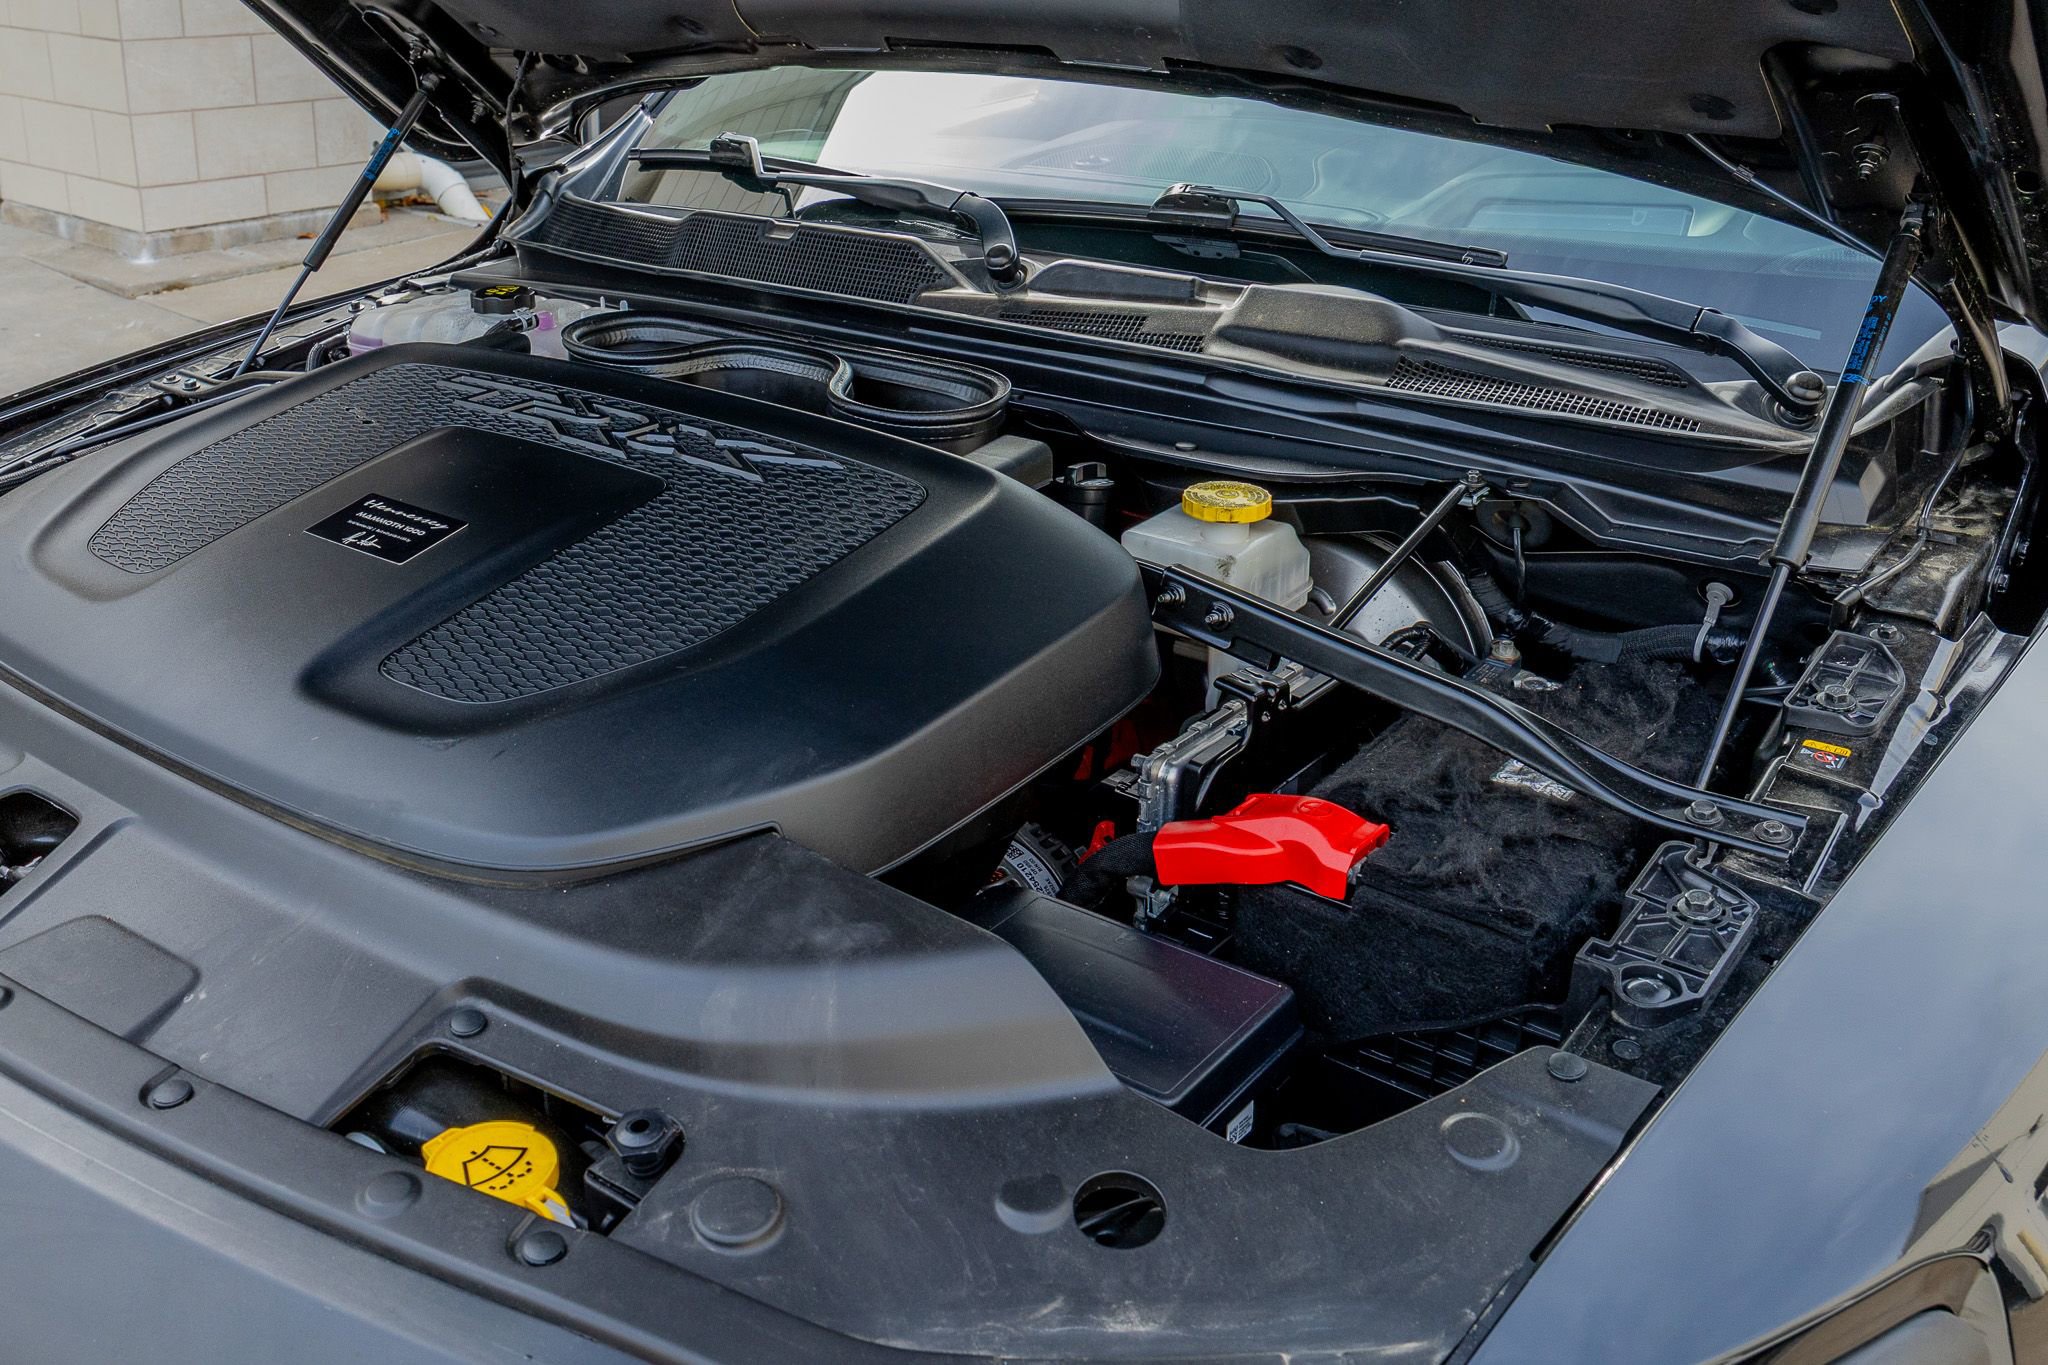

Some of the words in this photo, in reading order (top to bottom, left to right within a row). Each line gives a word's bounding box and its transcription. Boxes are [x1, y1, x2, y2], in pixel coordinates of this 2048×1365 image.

[437, 375, 847, 483] TRX
[355, 511, 405, 531] MAMMOTH
[402, 524, 427, 537] 1000
[363, 499, 449, 530] Hennessey
[1016, 862, 1044, 894] 254210
